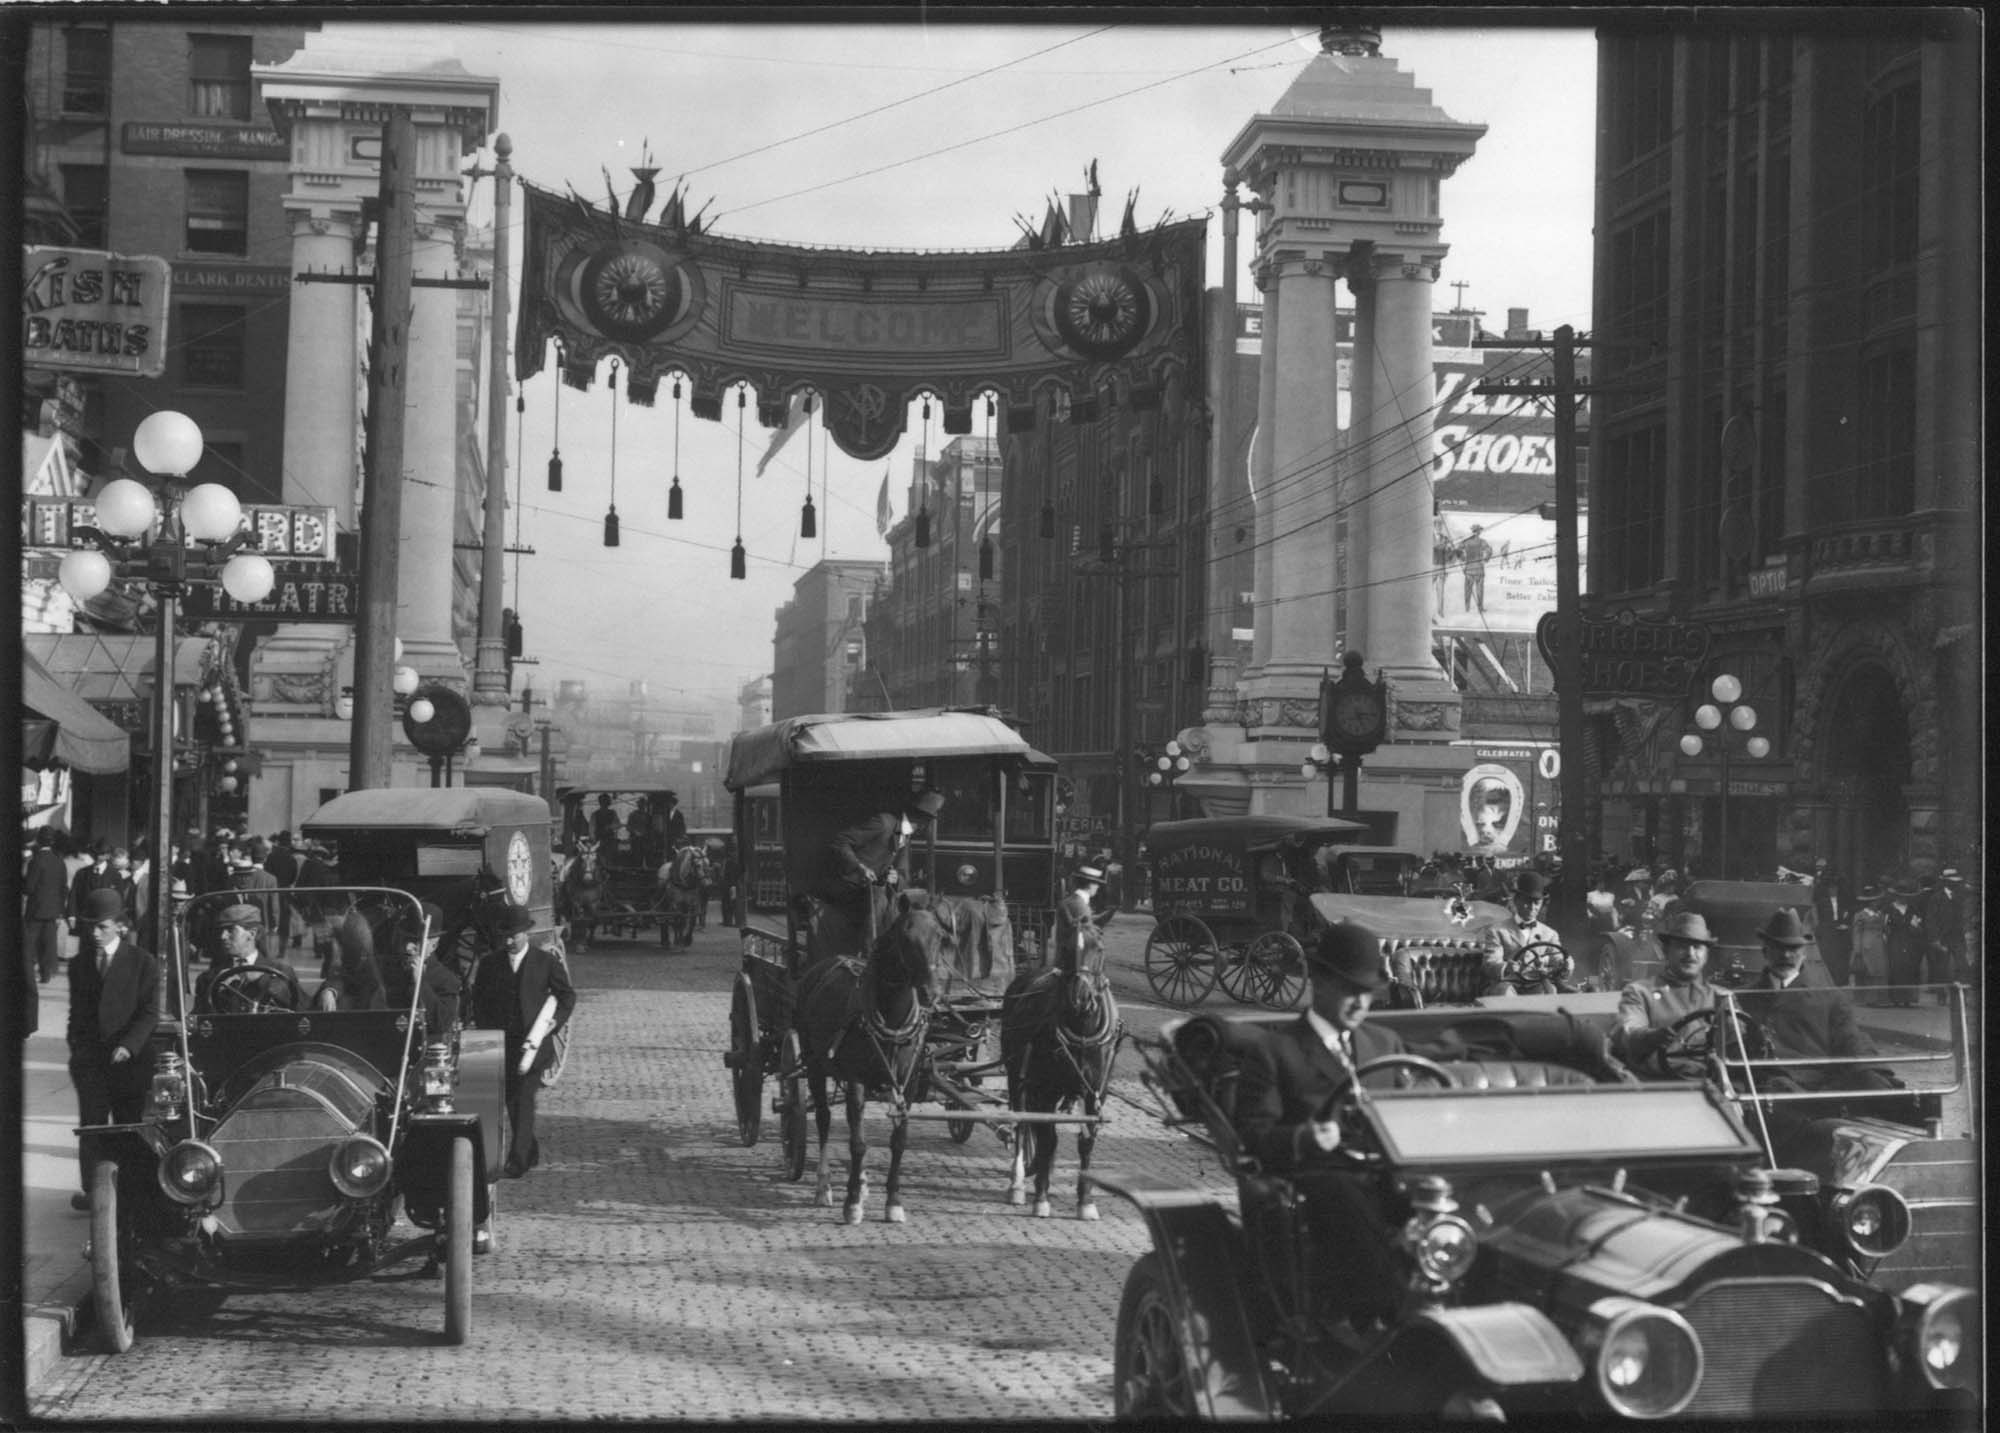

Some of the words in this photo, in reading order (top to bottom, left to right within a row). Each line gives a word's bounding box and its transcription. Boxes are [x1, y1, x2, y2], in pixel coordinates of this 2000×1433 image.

[174, 271, 230, 287] CLARK
[25, 315, 149, 357] BATHS
[749, 300, 985, 345] WELCOME
[1158, 844, 1243, 874] NATIONAL
[1158, 876, 1211, 893] MEAT
[1217, 876, 1249, 893] CO.
